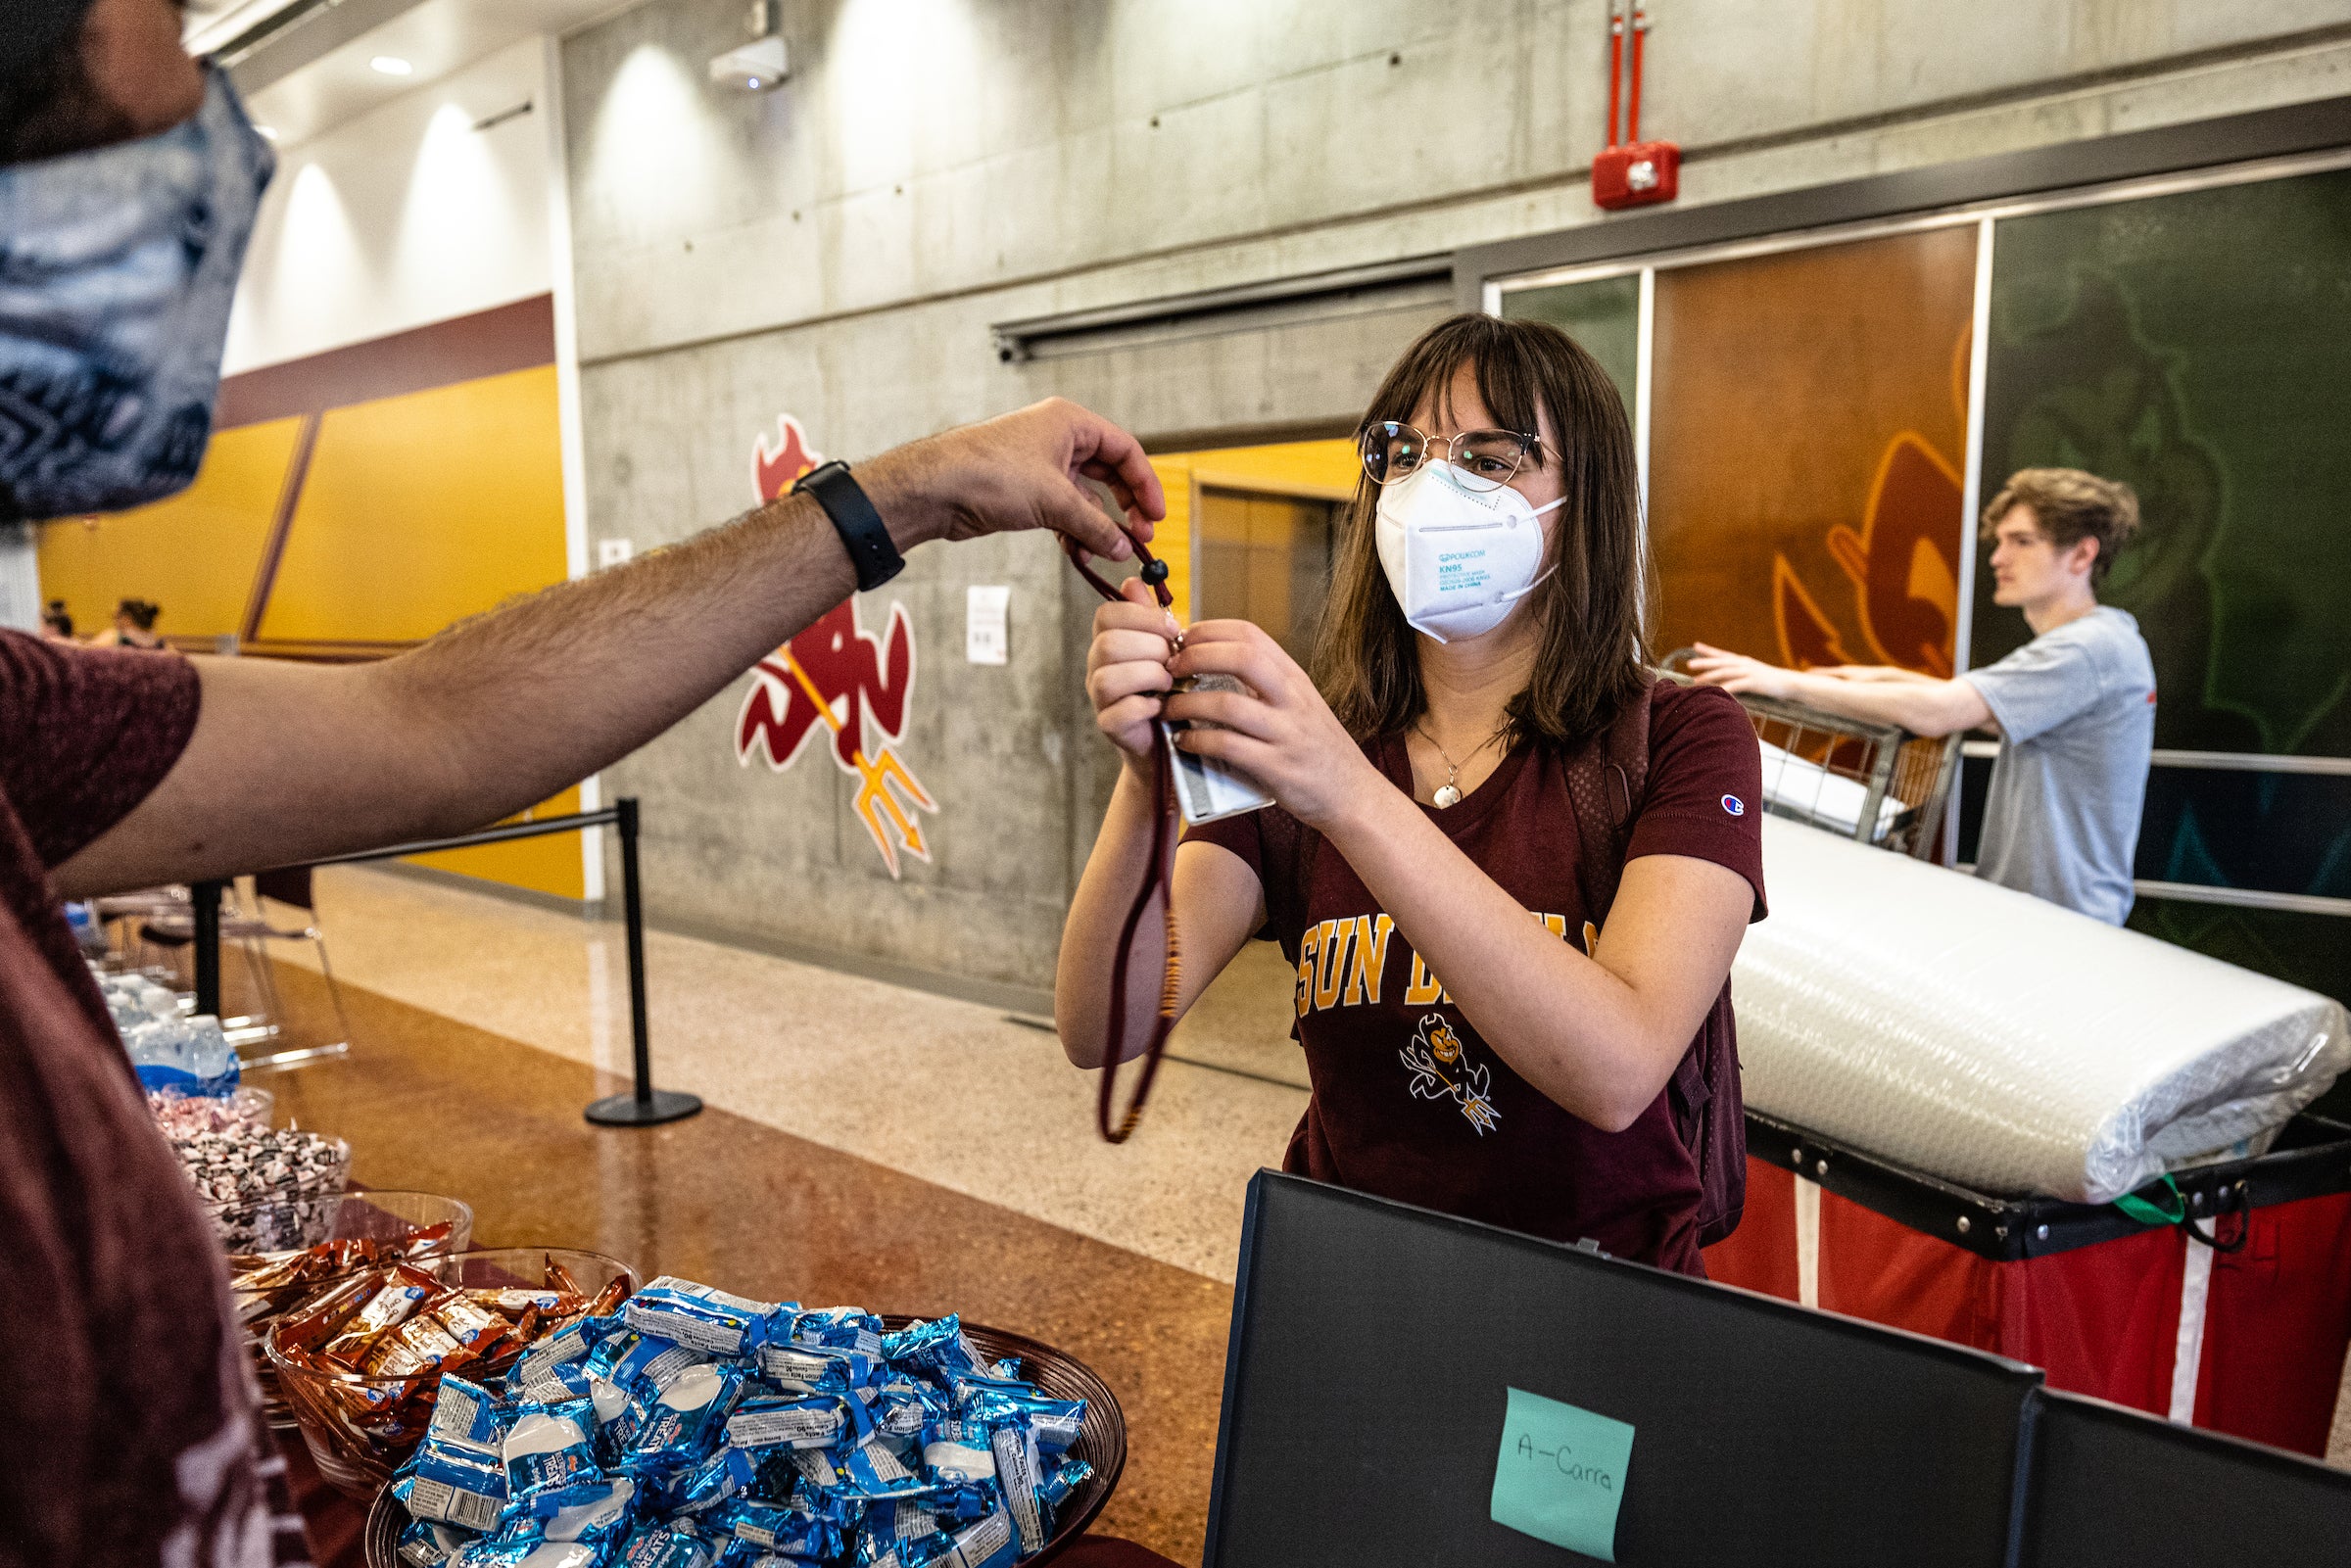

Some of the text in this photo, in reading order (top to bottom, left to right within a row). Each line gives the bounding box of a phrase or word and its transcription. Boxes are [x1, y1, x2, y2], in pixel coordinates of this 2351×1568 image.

[1440, 564, 1463, 573] KN95
[1298, 913, 1395, 1019] SUN
[639, 1532, 671, 1568] REATS
